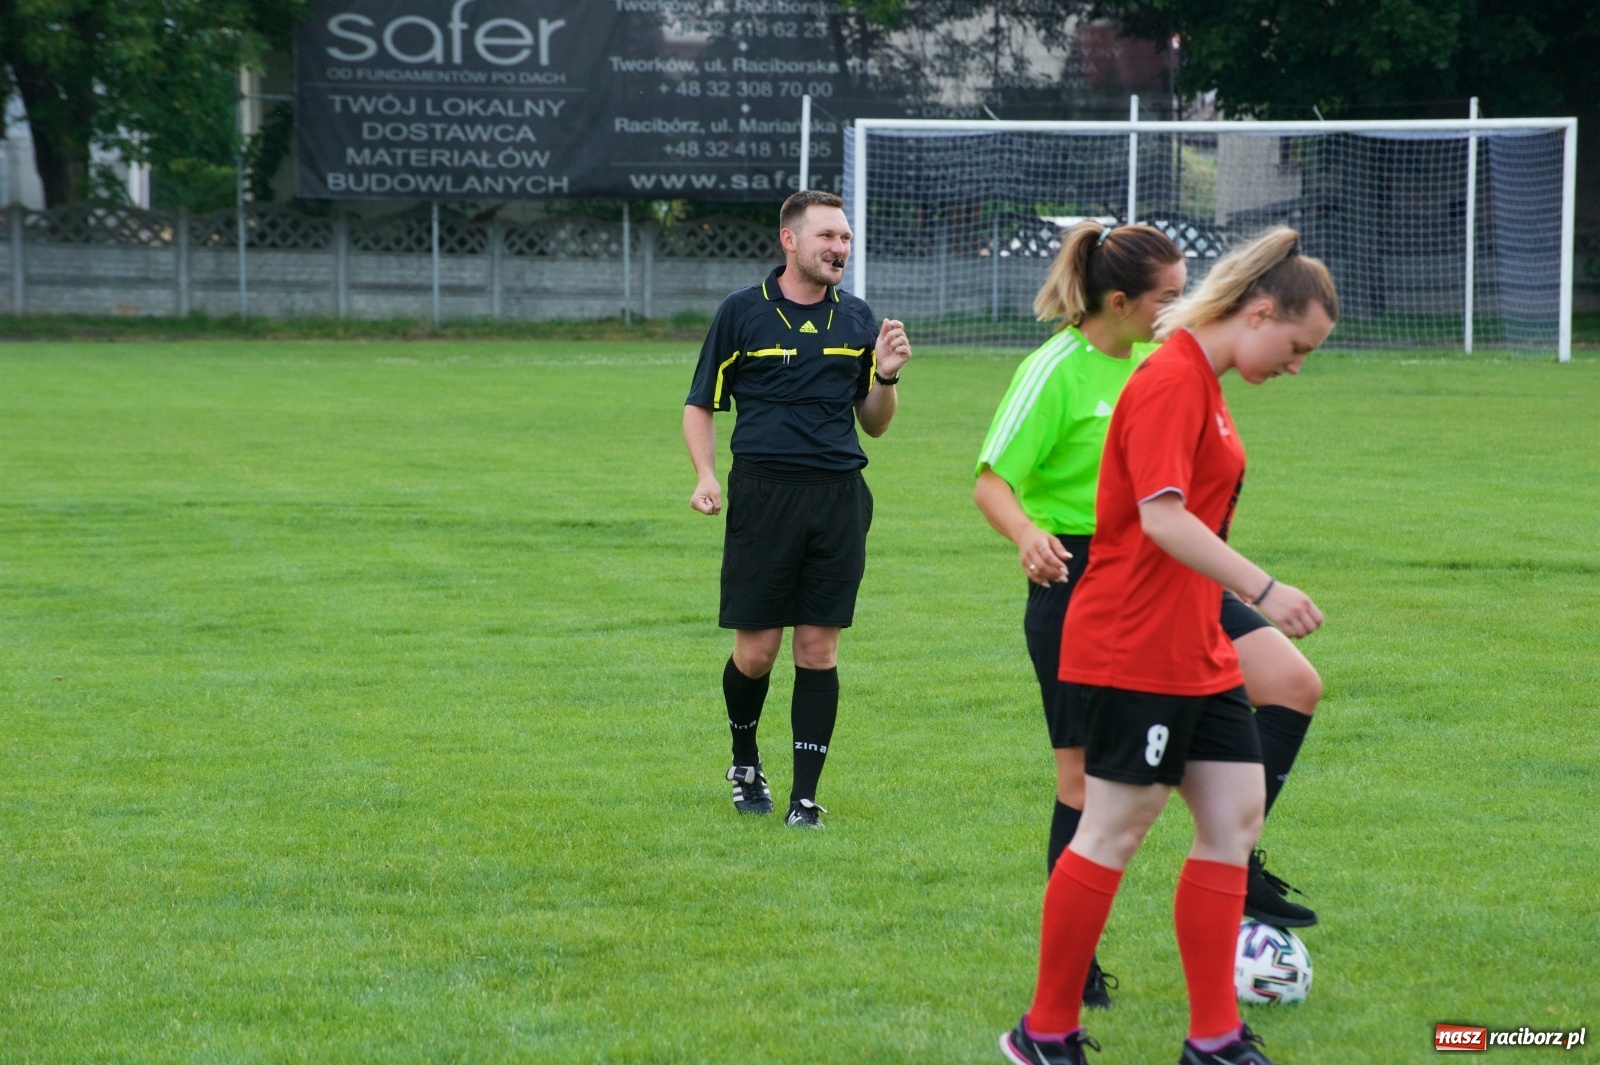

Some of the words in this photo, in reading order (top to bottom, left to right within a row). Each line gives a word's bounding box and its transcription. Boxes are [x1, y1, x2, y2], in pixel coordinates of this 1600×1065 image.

[326, 0, 566, 66] safer
[731, 21, 768, 38] 419
[773, 22, 798, 38] 62
[803, 22, 828, 39] 23
[327, 67, 352, 81] OD
[356, 67, 488, 84] FUNDAMENTÓW
[491, 71, 516, 84] PO
[519, 71, 566, 85] DACH
[609, 56, 700, 76] Tworków,
[704, 57, 727, 73] ul.
[733, 57, 840, 74] Raciborska
[675, 80, 701, 97] 48
[706, 81, 731, 97] 32
[736, 81, 773, 97] 308
[778, 81, 803, 98] 70
[808, 81, 833, 98] 00
[328, 93, 416, 116] TWÓJ
[425, 98, 566, 118] LOKALNY
[362, 121, 537, 142] DOSTAWCA
[614, 117, 706, 135] Racibórz,
[711, 118, 734, 134] ul.
[346, 146, 551, 169] MATERIAŁÓW
[705, 141, 729, 158] 32
[735, 141, 771, 158] 418
[327, 172, 569, 194] BUDOWLANYCH
[795, 741, 828, 754] zina
[1144, 724, 1170, 767] 8
